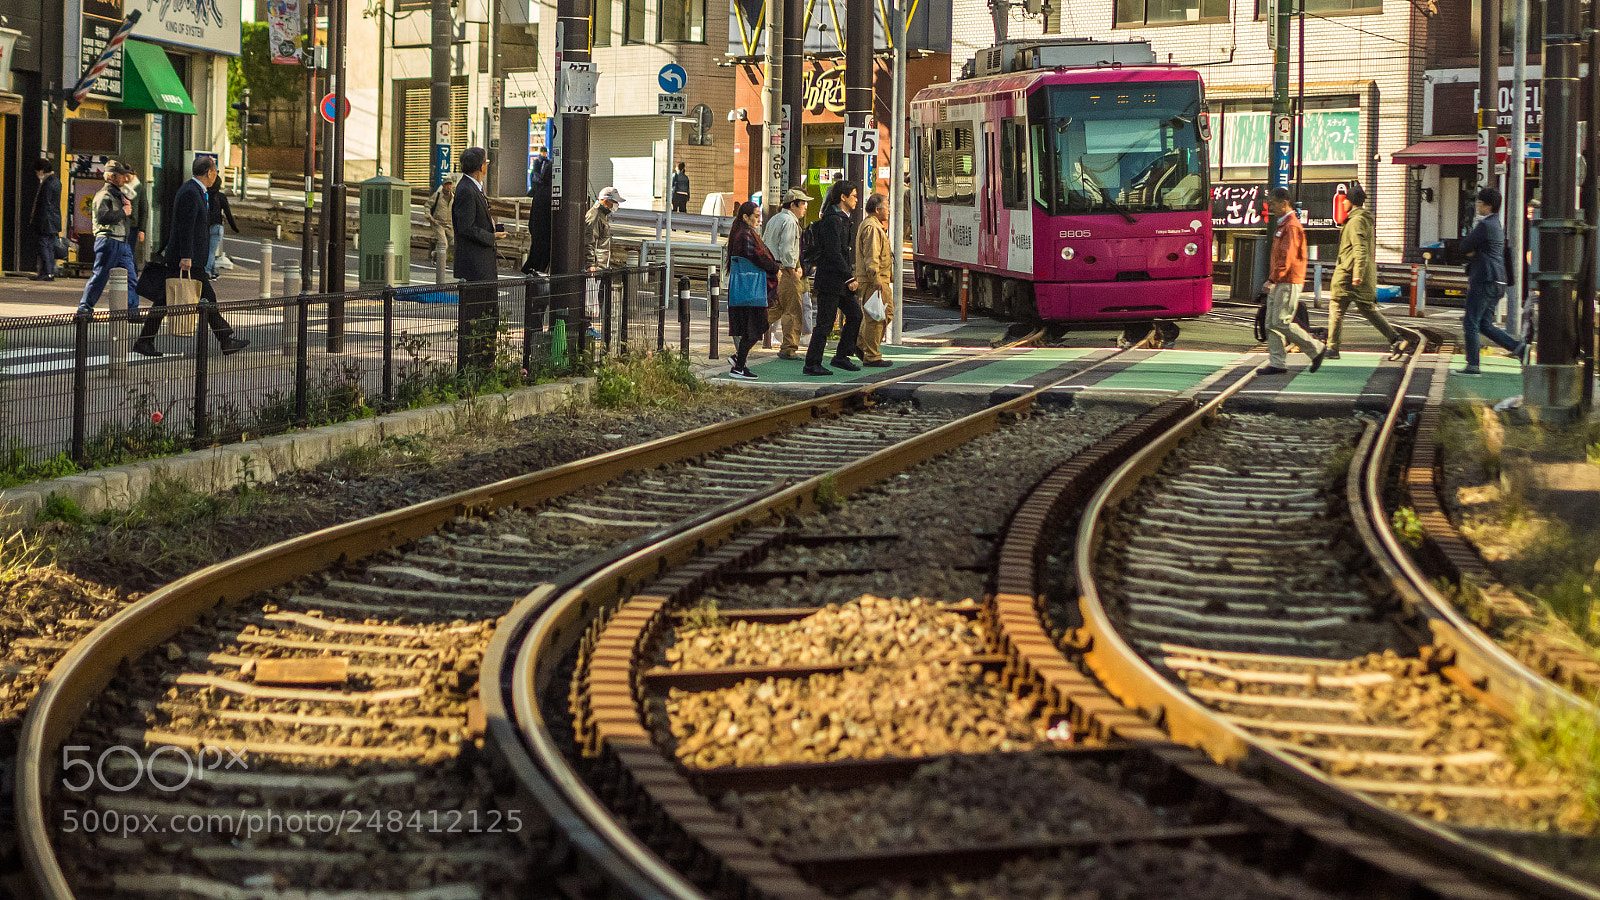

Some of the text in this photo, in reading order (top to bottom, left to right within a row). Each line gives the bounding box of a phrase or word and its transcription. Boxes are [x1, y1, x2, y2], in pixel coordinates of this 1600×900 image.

[165, 20, 205, 39] KING OF SYSTEM
[847, 129, 876, 153] 15
[1059, 229, 1092, 238] 8805
